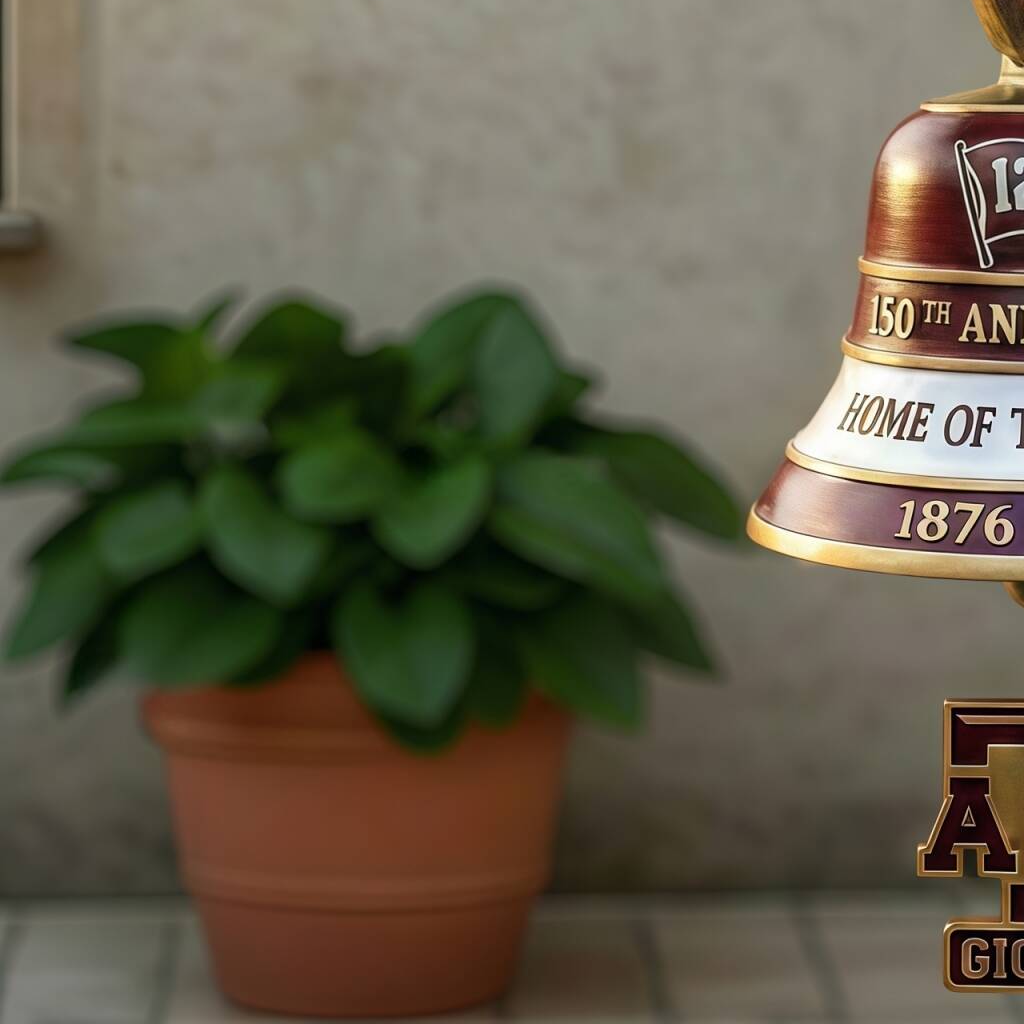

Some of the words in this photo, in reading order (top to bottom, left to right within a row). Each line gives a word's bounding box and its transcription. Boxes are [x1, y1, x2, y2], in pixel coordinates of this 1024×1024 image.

[837, 392, 935, 442] HOME
[943, 404, 997, 449] OF
[894, 499, 1016, 546] 1876
